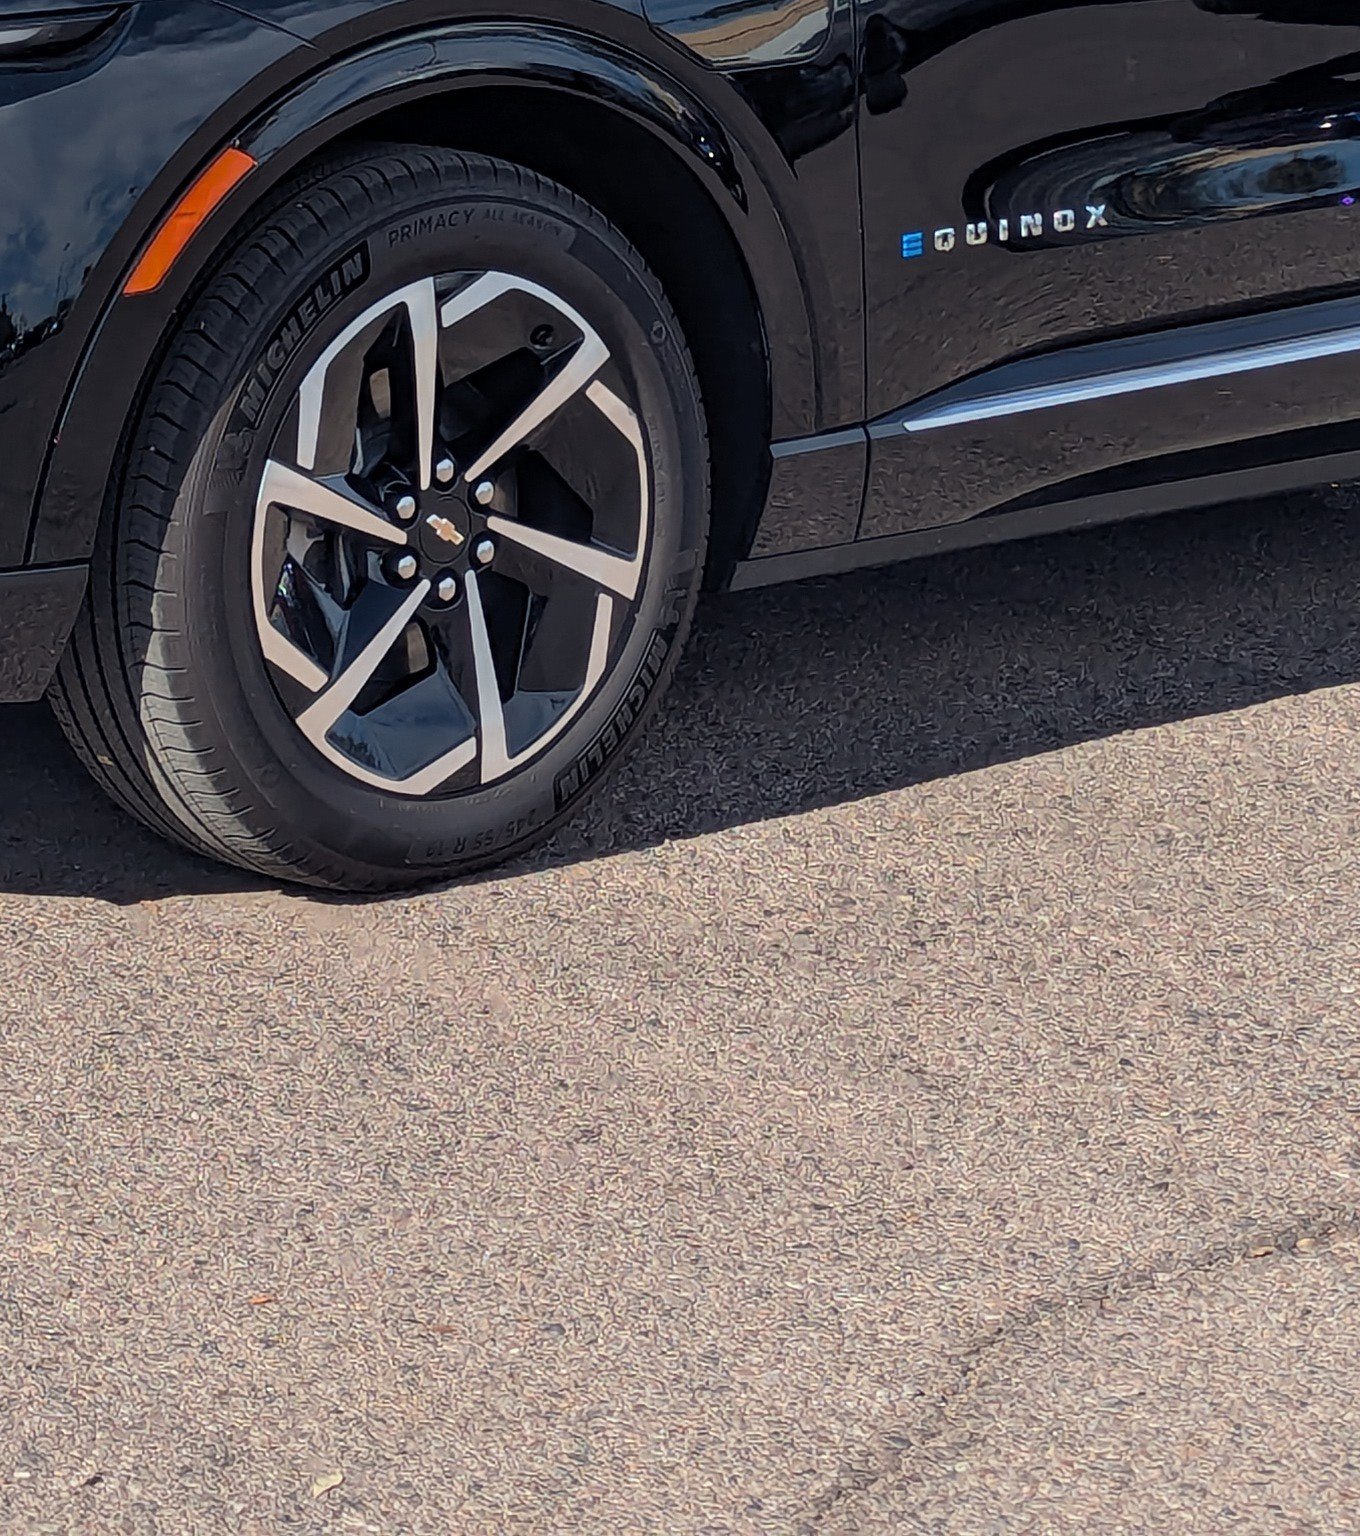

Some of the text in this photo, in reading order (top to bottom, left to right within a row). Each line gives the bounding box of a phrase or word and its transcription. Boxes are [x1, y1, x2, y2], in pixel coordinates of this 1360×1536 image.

[387, 208, 476, 248] PRIMACY
[901, 204, 1109, 260] EQUINOX
[240, 251, 365, 421] MICHELIN
[560, 634, 668, 801] MICHELIN
